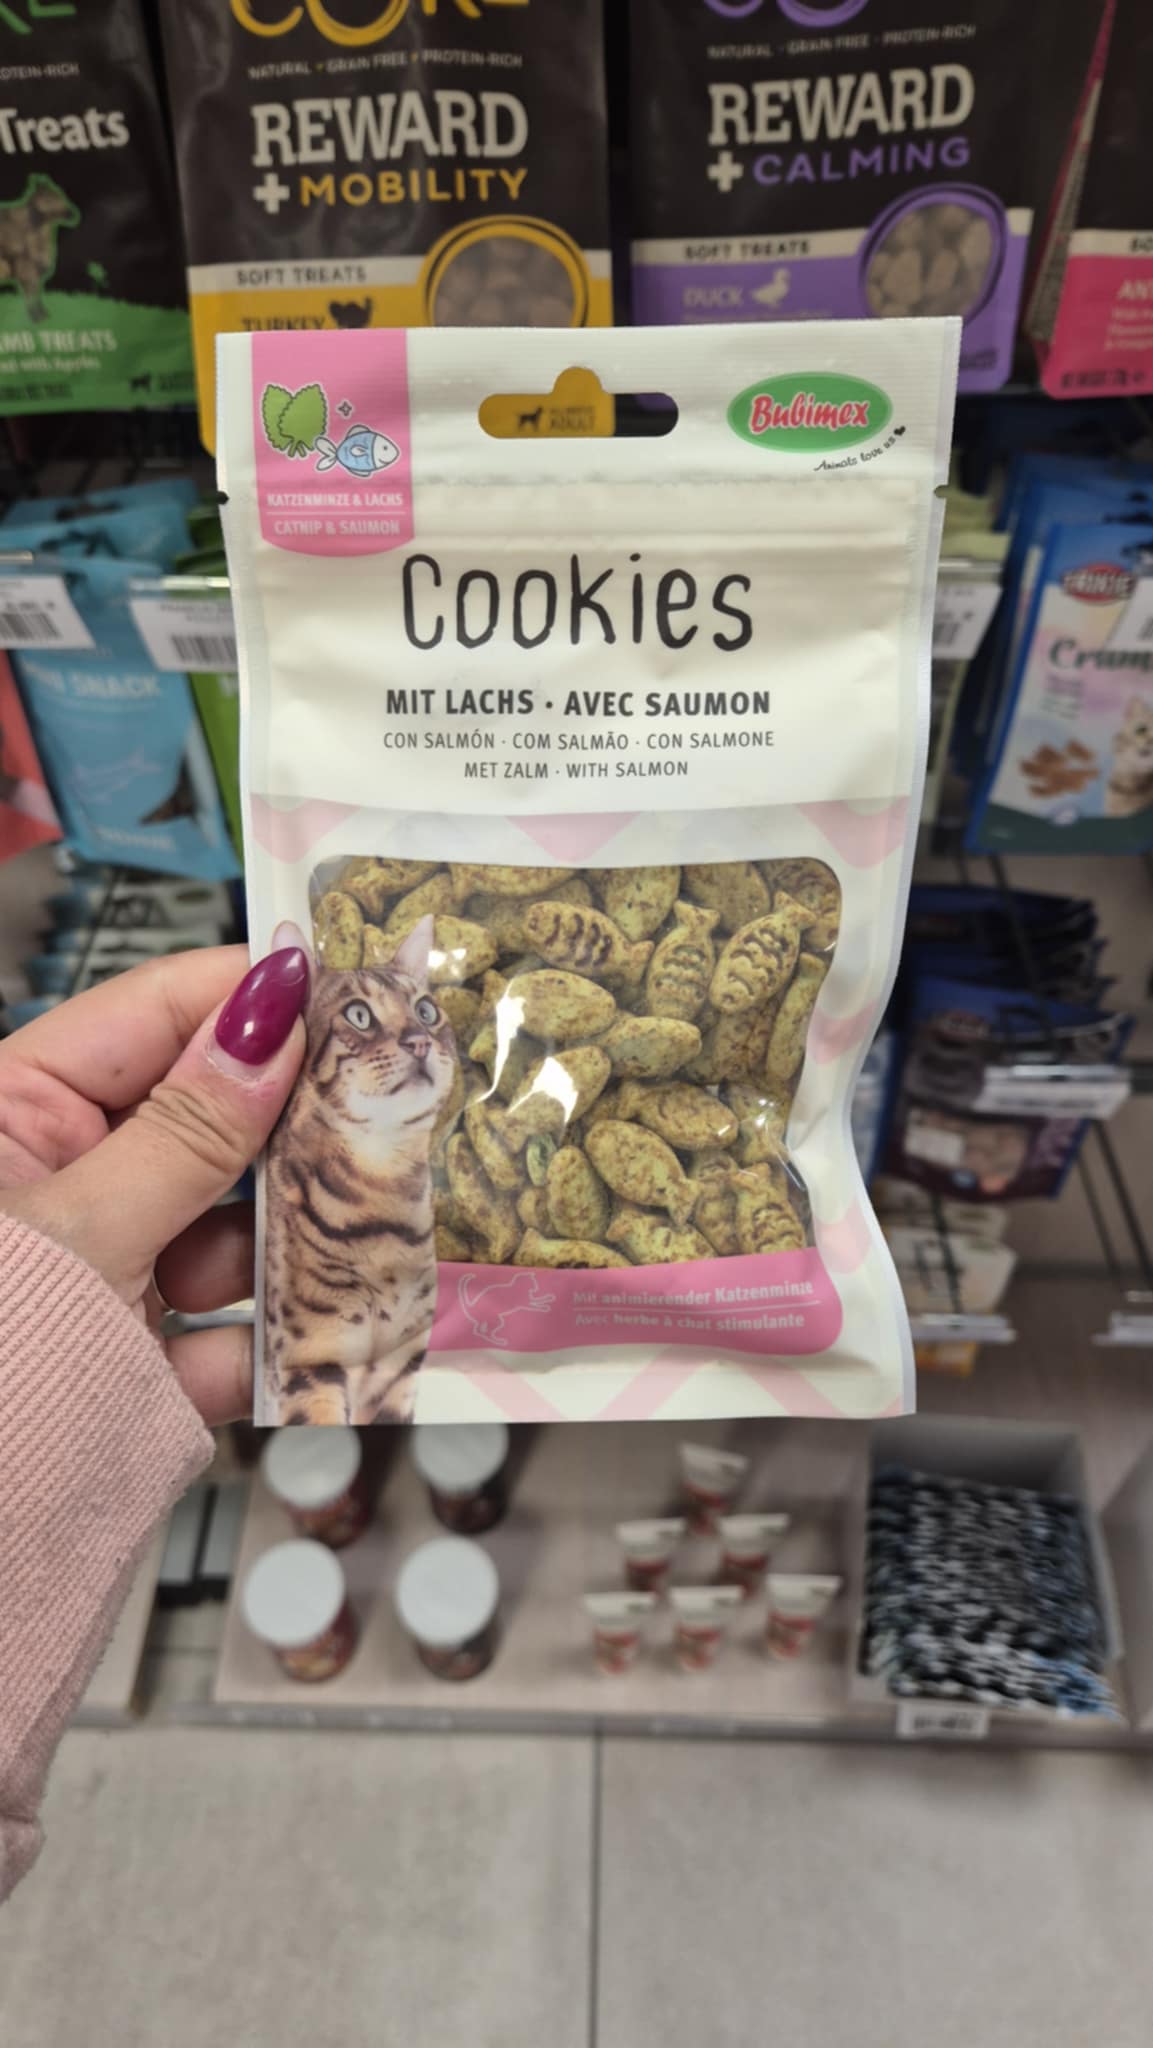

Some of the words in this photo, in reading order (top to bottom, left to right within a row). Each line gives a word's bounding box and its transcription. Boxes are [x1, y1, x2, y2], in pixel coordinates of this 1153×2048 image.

[707, 44, 774, 60] NATURAL
[787, 37, 833, 55] GRAIN
[835, 33, 869, 50] FREE
[883, 24, 977, 46] PROTEIN-RICH
[248, 61, 312, 79] NATURAL
[326, 55, 371, 74] GRAIN
[373, 51, 407, 69] FREE
[421, 50, 523, 68] PROTEIN-RICH
[707, 62, 976, 147] REWARD
[0, 107, 130, 154] Treats
[251, 89, 530, 168] REWARD
[741, 239, 810, 257] TREATS
[236, 268, 285, 286] SOFT
[292, 265, 367, 283] TREATS
[39, 329, 118, 352] TREATS
[749, 391, 870, 435] Bubimex
[813, 456, 858, 471] Animals
[859, 447, 884, 463] love
[883, 435, 897, 450] us
[266, 493, 350, 507] KATZENMINZE
[352, 493, 363, 507] &
[365, 493, 404, 507] LACHS
[274, 519, 322, 536] CATNIP
[325, 519, 337, 536] &
[339, 519, 400, 536] SAUMON
[402, 553, 754, 651] Cookies
[386, 689, 436, 715] MIT
[446, 689, 534, 715] LACHS
[563, 690, 635, 717] AVEC
[644, 690, 771, 717] SAUMON
[384, 732, 418, 749] CON
[424, 728, 495, 749] SALMÓN
[512, 732, 551, 750] COM
[557, 731, 630, 751] SALMÃO
[646, 733, 683, 750] CON
[689, 730, 775, 749] SALMONE
[464, 762, 498, 778] MET
[503, 762, 549, 779] ZALM
[566, 762, 609, 779] WITH
[615, 760, 689, 778] SALMON
[714, 1280, 814, 1304] Katzenminze
[612, 1313, 659, 1327] herbe
[715, 1313, 806, 1331] stimulante
